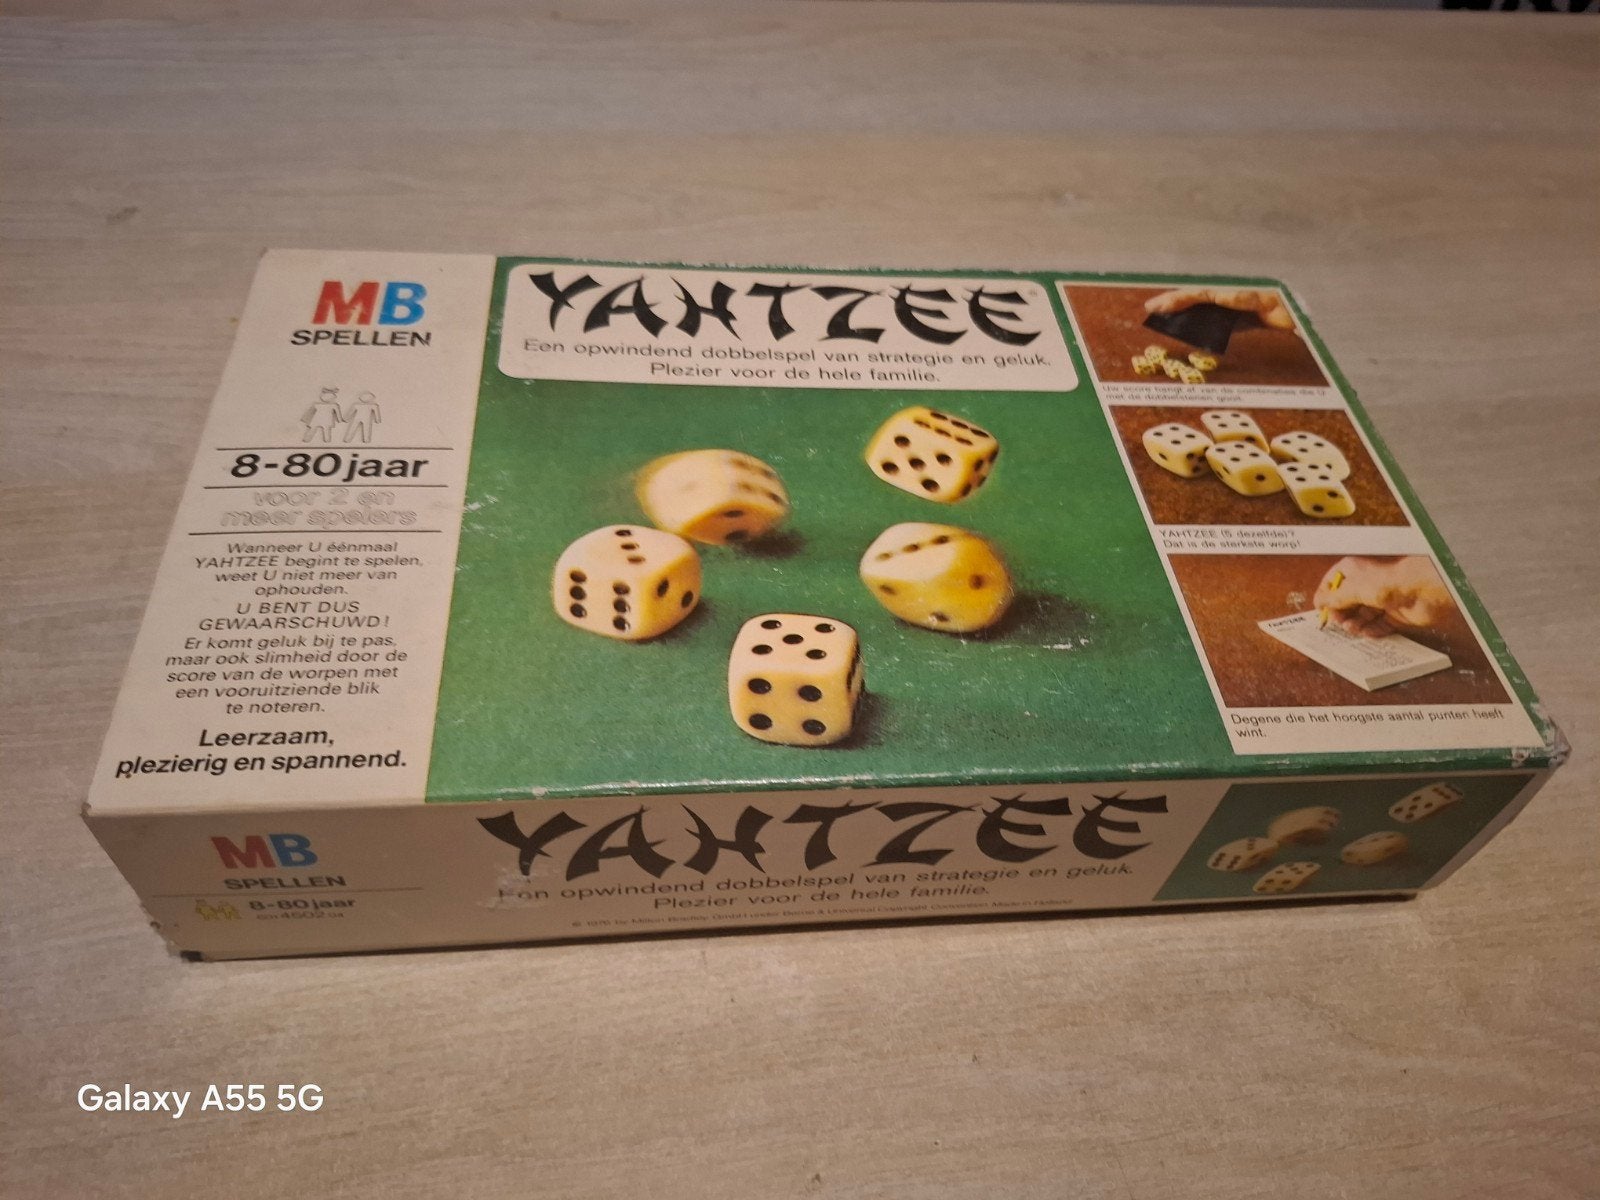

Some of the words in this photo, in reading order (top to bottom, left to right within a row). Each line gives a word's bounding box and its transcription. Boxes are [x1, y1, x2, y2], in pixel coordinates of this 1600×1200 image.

[311, 280, 427, 325] MB
[529, 271, 1042, 346] YAHTZEE
[290, 329, 432, 348] SPELLEN
[523, 338, 565, 353] Een
[574, 342, 692, 359] opwindend
[702, 346, 816, 362] dobbelspel
[825, 352, 859, 362] van
[868, 352, 953, 367] strategie
[962, 355, 985, 365] en
[993, 353, 1051, 368] geluk.
[650, 362, 722, 378] Plezier
[730, 368, 776, 379] voor
[785, 368, 810, 380] de
[819, 368, 861, 381] hele
[870, 368, 941, 382] familie.
[253, 491, 321, 506] voor
[329, 487, 349, 505] 2
[357, 490, 396, 506] en
[219, 510, 303, 526] meer
[306, 509, 418, 530] spelers
[1159, 529, 1216, 538] YAHTZEE
[227, 542, 303, 553] Wanneer
[309, 542, 322, 553] U
[327, 541, 398, 553] éénmaal
[1163, 540, 1183, 548] Dat
[1187, 540, 1197, 548] is
[1201, 540, 1216, 548] de
[1220, 540, 1265, 548] sterkste
[195, 556, 279, 568] YAHTZEE
[285, 555, 338, 569] begint
[344, 556, 360, 566] te
[215, 571, 258, 582] weet
[262, 570, 277, 582] U
[282, 570, 314, 581] niet
[319, 571, 362, 581] meer
[367, 571, 398, 581] van
[254, 582, 348, 598] ophouden.
[236, 603, 251, 615] U
[259, 602, 312, 614] BENT
[318, 601, 360, 613] DUS
[184, 637, 201, 650] Er
[207, 636, 252, 649] komt
[257, 635, 307, 651] geluk
[313, 634, 335, 650] bij
[341, 636, 357, 647] te
[165, 655, 209, 667] maar
[215, 652, 249, 665] ook
[254, 650, 332, 664] slimheid
[337, 650, 379, 662] door
[385, 649, 408, 662] de
[166, 670, 217, 682] score
[222, 669, 254, 681] van
[260, 667, 283, 680] de
[289, 667, 358, 682] worpen
[364, 666, 398, 678] met
[175, 687, 209, 699] een
[215, 683, 342, 698] vooruitziende
[347, 681, 380, 695] blik
[226, 702, 243, 715] te
[249, 701, 325, 714] noteren.
[1231, 713, 1282, 727] Degene
[1285, 713, 1305, 724] die
[1310, 713, 1330, 723] het
[1333, 712, 1384, 726] hoogste
[1388, 711, 1424, 721] aantal
[1428, 711, 1469, 723] punten
[1472, 708, 1504, 720] heeft
[199, 729, 335, 747] Leerzaam,
[1237, 727, 1267, 738] wint.
[115, 754, 228, 778] plezierig
[234, 756, 266, 771] en
[270, 750, 406, 773] spannend.
[475, 791, 1168, 882] YAHTZEE
[210, 833, 318, 869] MB
[224, 875, 347, 891] SPELLEN
[561, 880, 705, 900] opwindend
[716, 873, 854, 893] dobbelspel
[865, 871, 906, 884] van
[916, 867, 1019, 884] strategie
[1029, 866, 1058, 878] en
[1067, 862, 1133, 880] geluk.
[654, 894, 737, 910] Plezier
[748, 892, 802, 905] voor
[810, 890, 840, 902] de
[851, 887, 901, 901] hele
[910, 883, 990, 898] familie.
